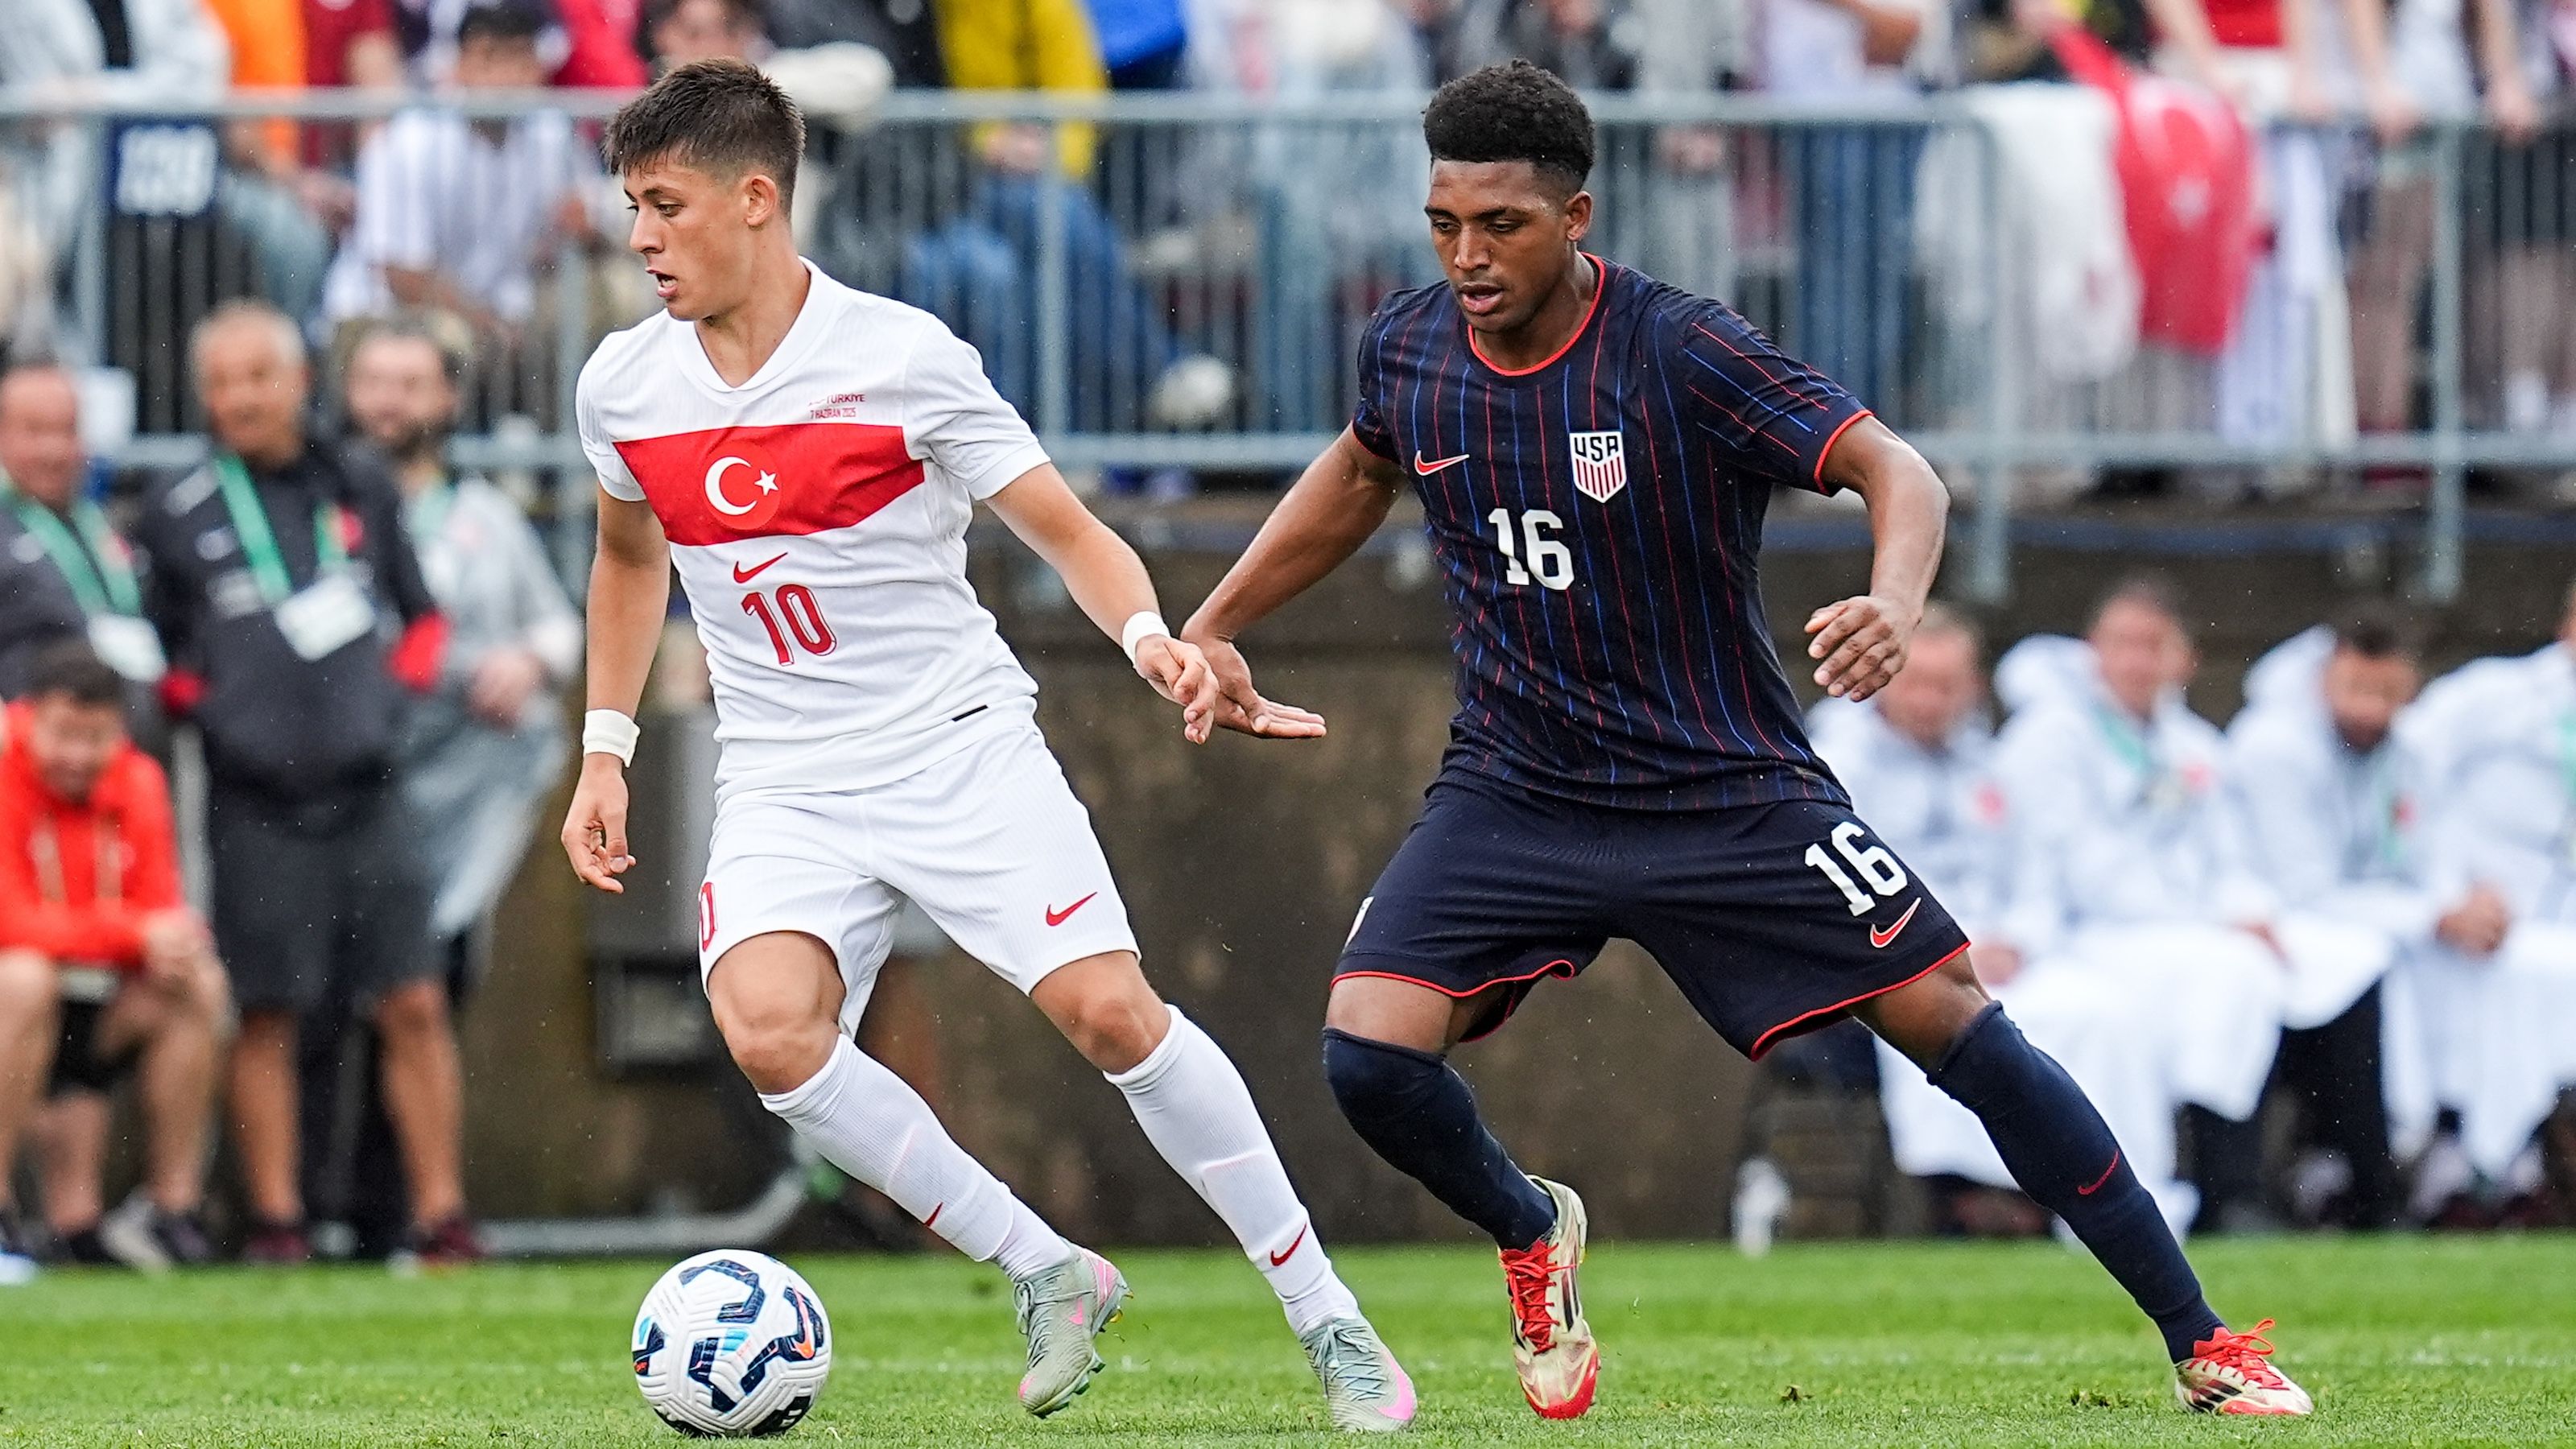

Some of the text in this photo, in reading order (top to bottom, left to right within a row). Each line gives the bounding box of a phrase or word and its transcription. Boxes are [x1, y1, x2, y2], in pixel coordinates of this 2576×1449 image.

[1574, 436, 1619, 462] USA
[1488, 508, 1575, 591] 16
[741, 584, 837, 667] 10
[1804, 821, 1908, 917] 16
